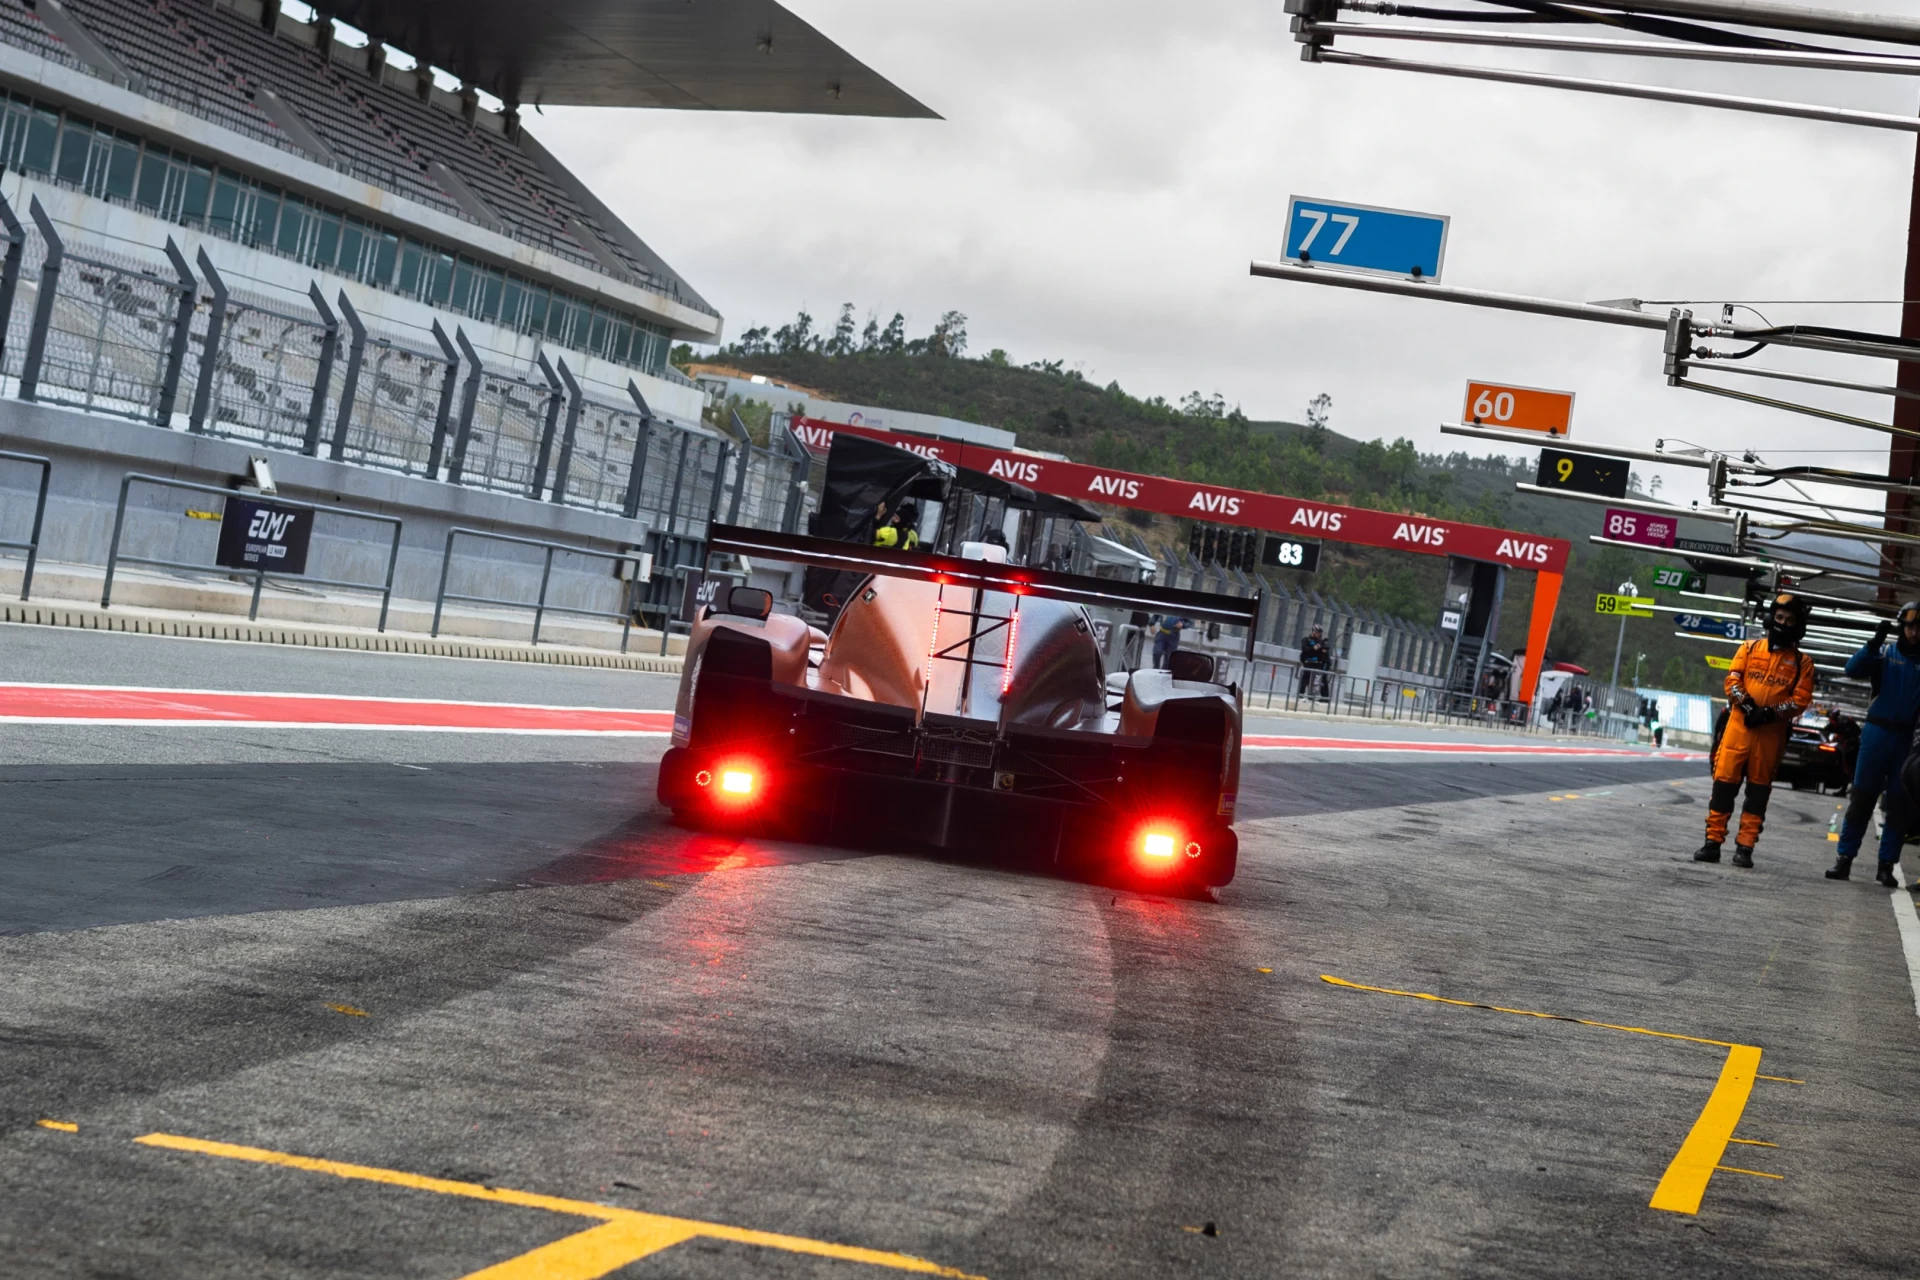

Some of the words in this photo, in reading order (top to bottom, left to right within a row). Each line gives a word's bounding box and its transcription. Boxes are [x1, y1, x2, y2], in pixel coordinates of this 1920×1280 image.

[1298, 208, 1360, 256] 77
[1473, 390, 1515, 421] 60
[988, 458, 1039, 482] AVIS
[1556, 458, 1574, 482] 9
[1088, 475, 1139, 499] AVIS
[1189, 491, 1240, 516] AVIS
[1290, 508, 1342, 532] AVIS
[1609, 514, 1637, 536] 85
[1393, 523, 1445, 546] AVIS
[1279, 543, 1303, 565] 83
[1496, 538, 1548, 563] AVIS
[1655, 570, 1683, 587] 30
[1598, 596, 1616, 612] 59
[1680, 614, 1702, 628] 28
[1725, 622, 1745, 639] 31
